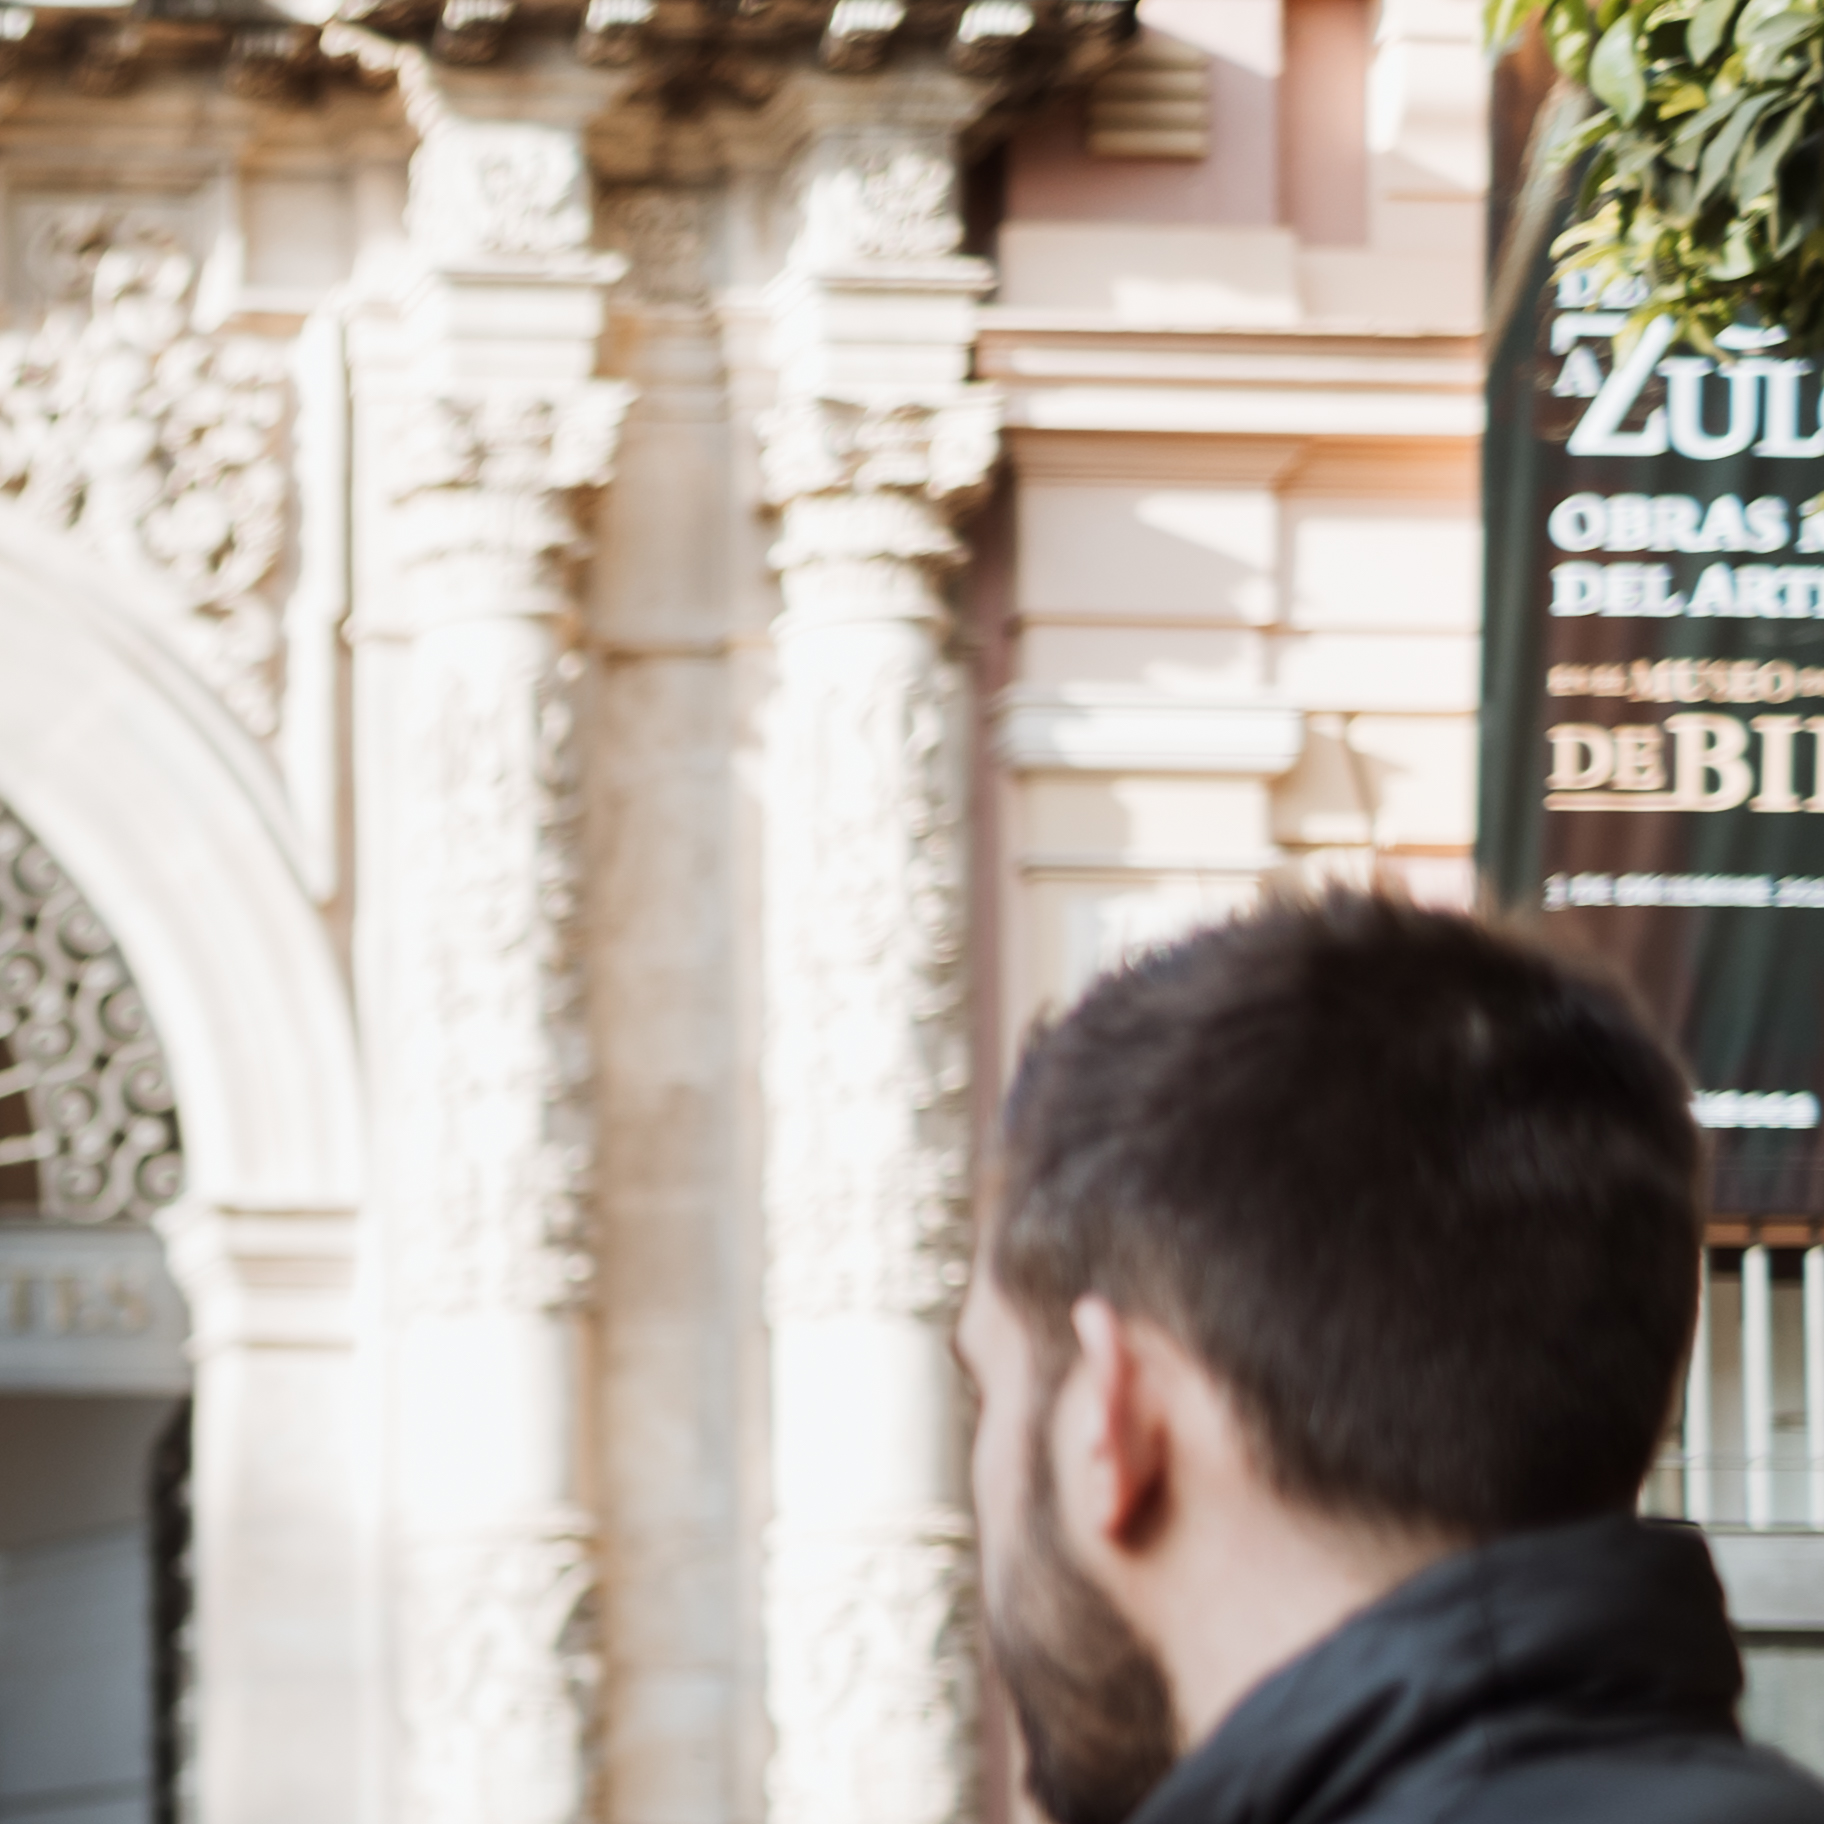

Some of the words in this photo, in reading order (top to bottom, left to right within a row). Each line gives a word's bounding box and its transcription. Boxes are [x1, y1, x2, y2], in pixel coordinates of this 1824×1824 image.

[1551, 311, 1824, 461] ZUL
[1548, 492, 1791, 553] OBRAS
[1549, 560, 1687, 617] DEL
[1627, 656, 1798, 704] MUSEO
[1545, 722, 1666, 790] DE
